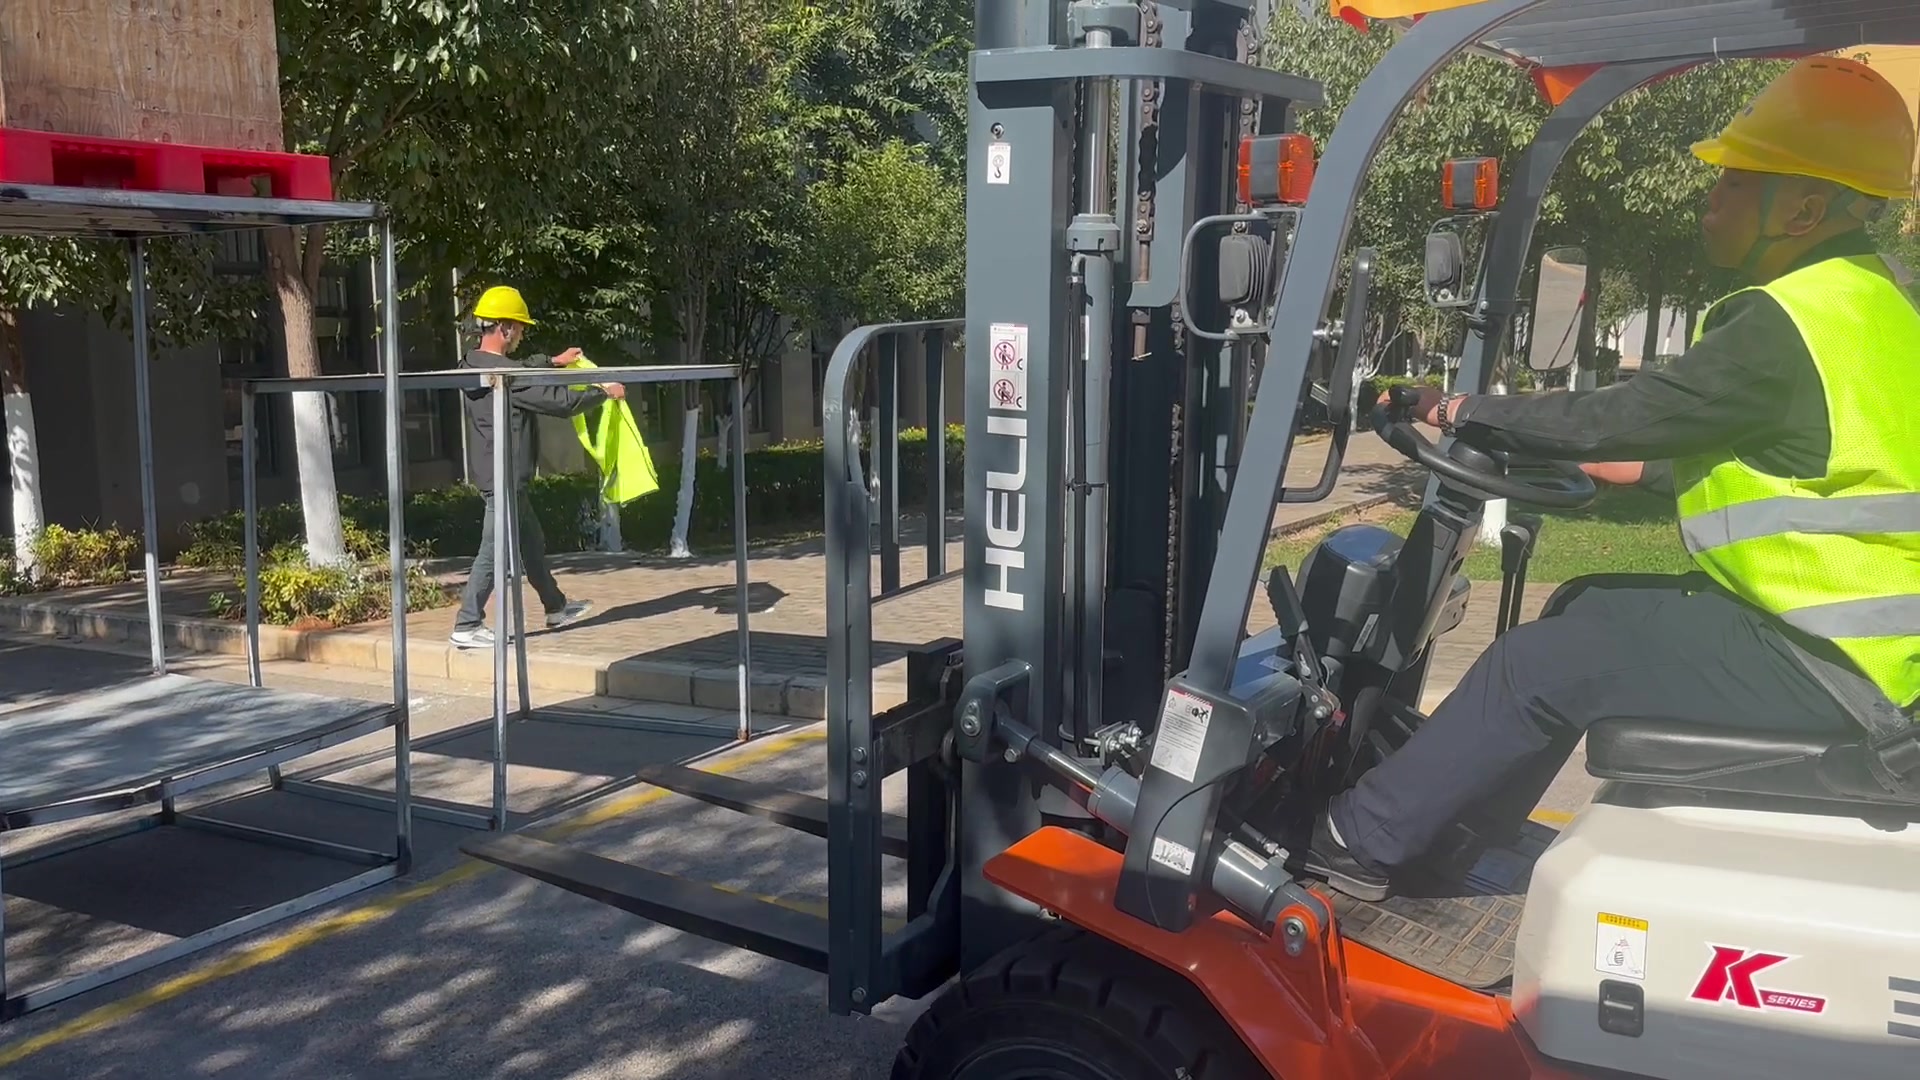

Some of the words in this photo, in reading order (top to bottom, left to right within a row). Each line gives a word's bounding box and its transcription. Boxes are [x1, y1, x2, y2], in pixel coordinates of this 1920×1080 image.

[984, 415, 1028, 611] HELI
[1690, 945, 1789, 1009] K
[1766, 994, 1818, 1009] SERIES
